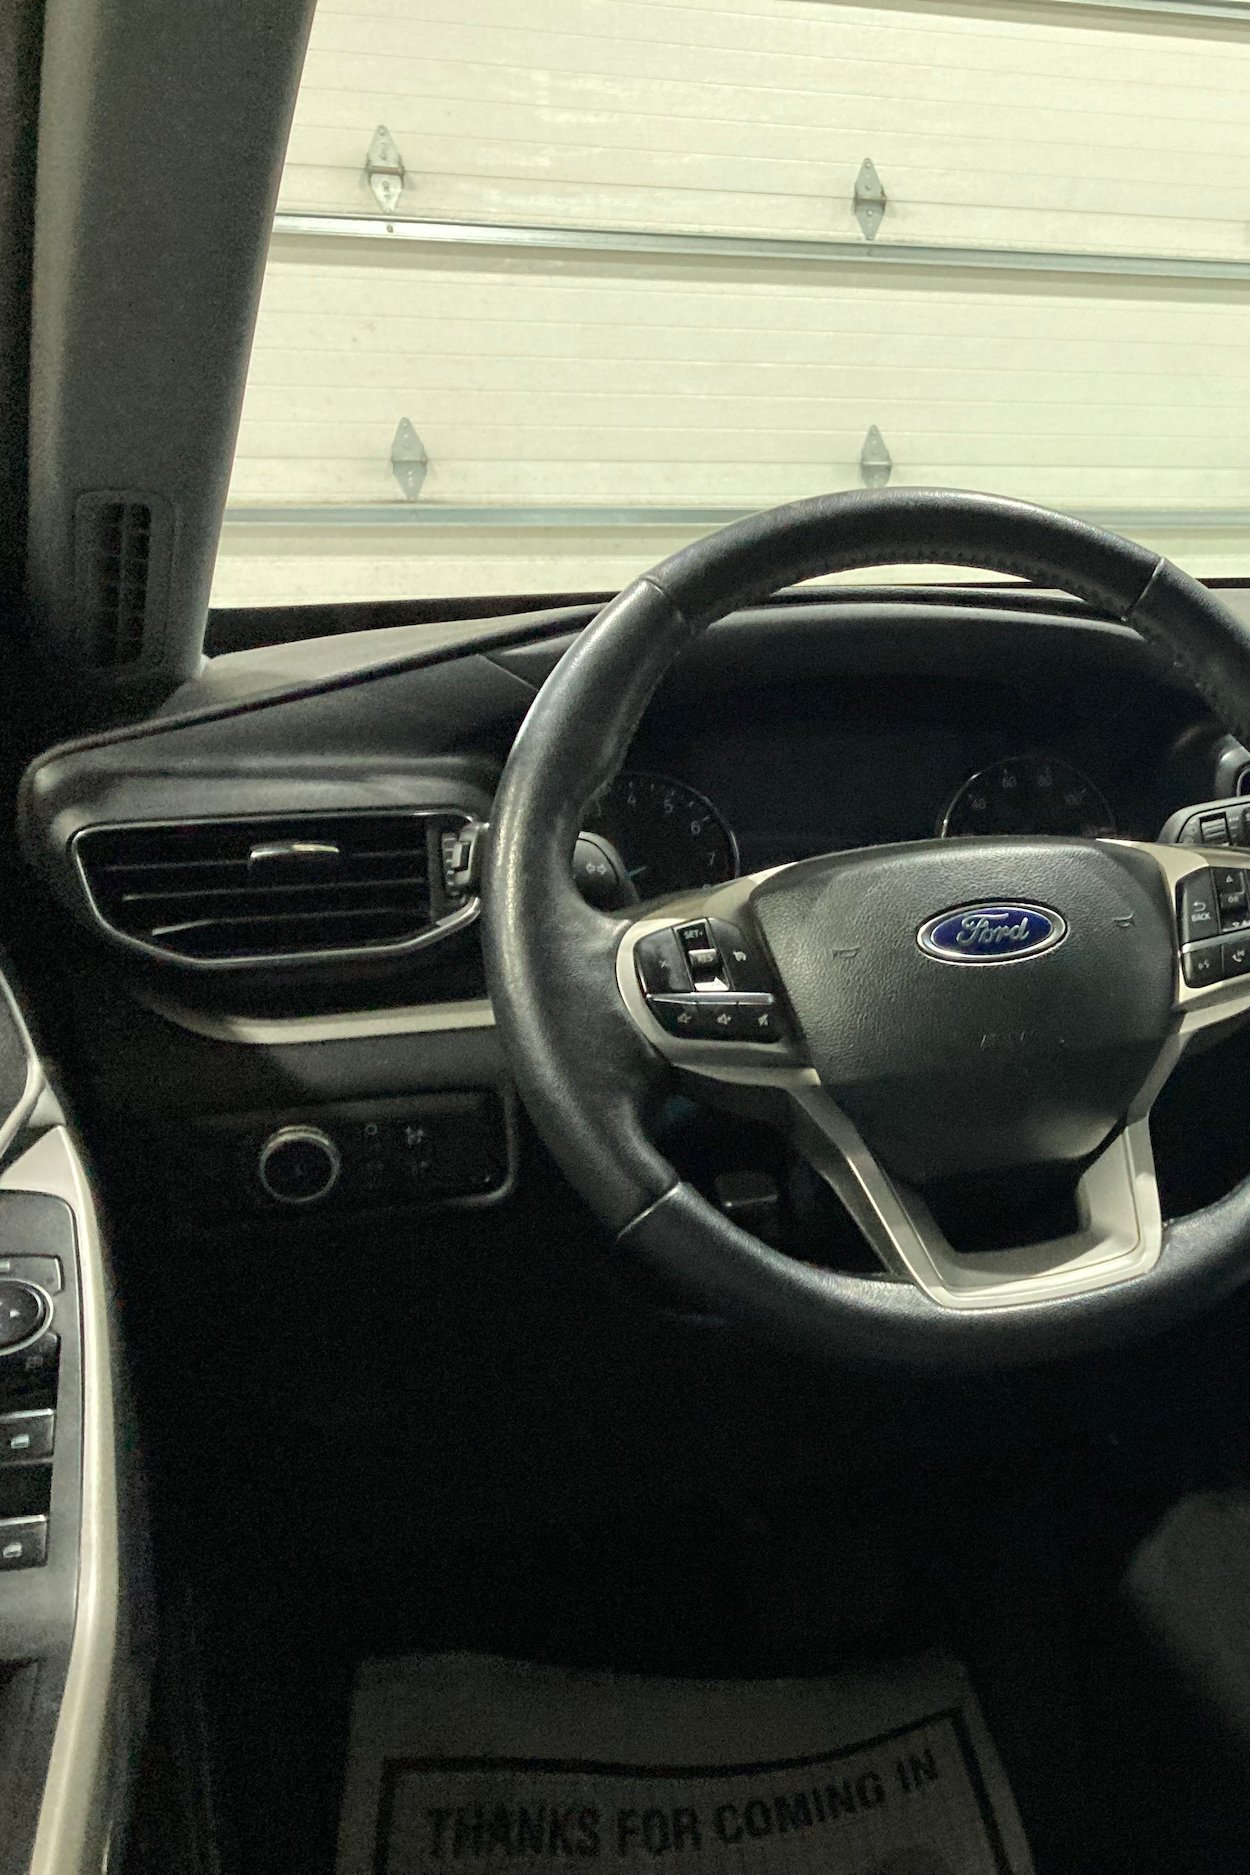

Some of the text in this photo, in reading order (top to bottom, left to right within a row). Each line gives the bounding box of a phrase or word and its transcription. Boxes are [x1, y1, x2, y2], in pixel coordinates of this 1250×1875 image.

[663, 799, 674, 814] 5
[690, 820, 701, 835] 6
[1190, 912, 1211, 922] BACK
[956, 912, 1030, 946] Ford
[426, 1746, 939, 1860] THANKS FOR COMING IN
